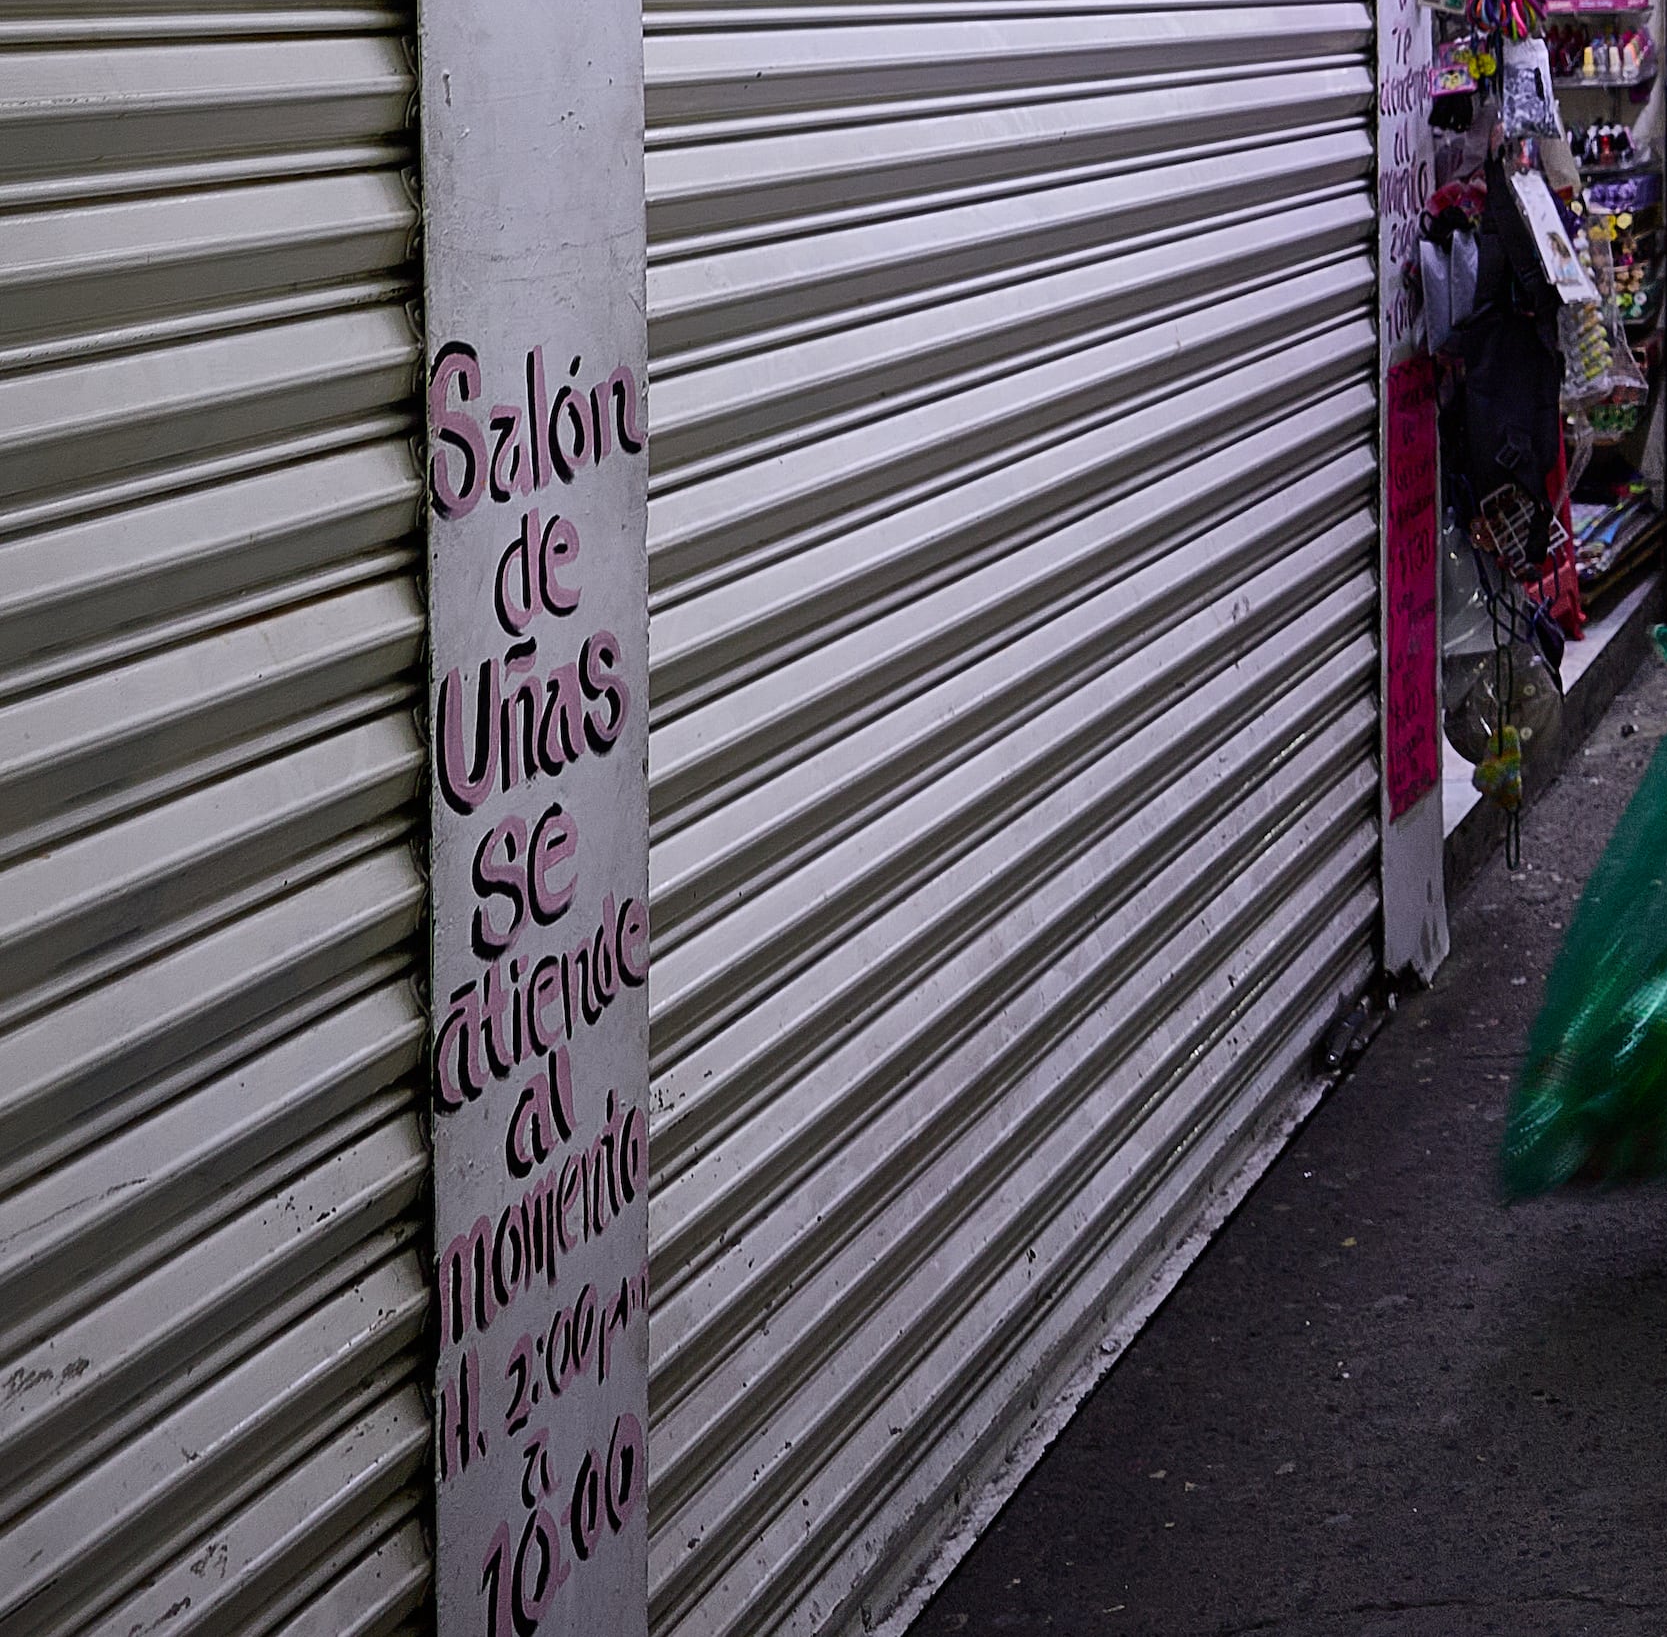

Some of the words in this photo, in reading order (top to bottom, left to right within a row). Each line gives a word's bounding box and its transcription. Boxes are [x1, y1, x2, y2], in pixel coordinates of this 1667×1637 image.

[428, 340, 648, 520] Salón
[494, 506, 582, 637] de
[433, 628, 632, 816] Uñas
[471, 802, 580, 962] se
[432, 892, 648, 1116] atiende
[504, 1045, 578, 1180] al
[438, 1088, 648, 1352] momento
